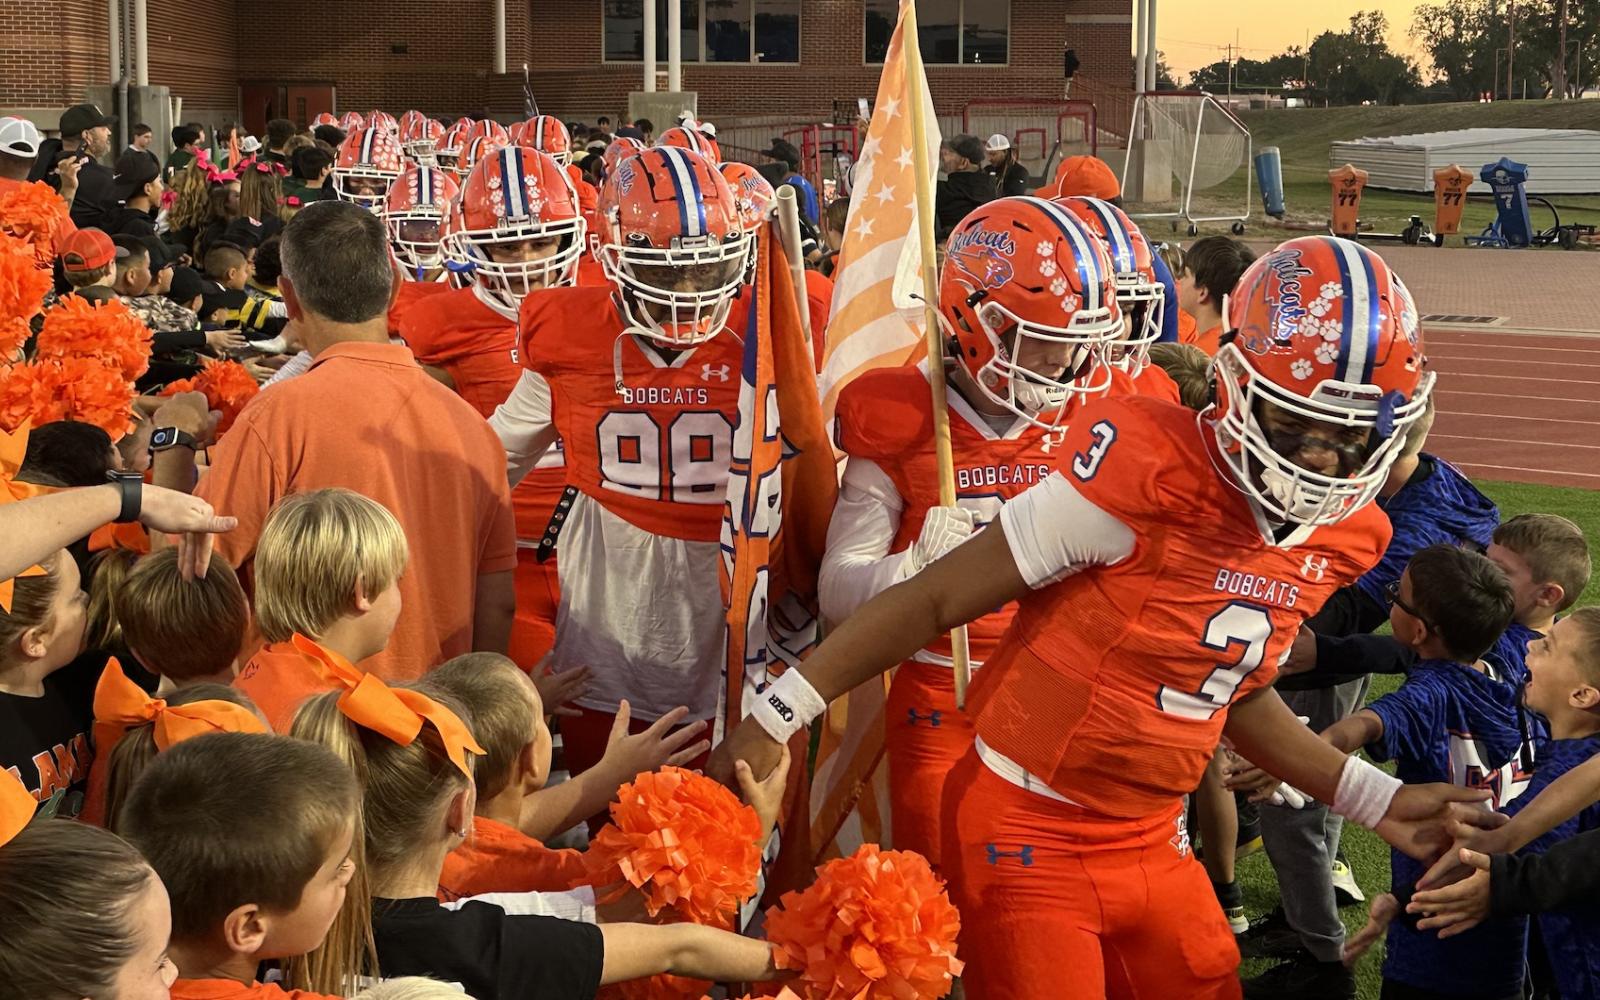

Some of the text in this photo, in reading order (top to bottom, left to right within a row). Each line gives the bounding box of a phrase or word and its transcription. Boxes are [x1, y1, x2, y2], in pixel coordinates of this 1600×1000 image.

[1338, 192, 1357, 206] 77
[1443, 192, 1462, 206] 77
[1500, 194, 1513, 209] 7
[622, 387, 709, 405] BOBCATS
[596, 410, 734, 505] 98
[1072, 419, 1118, 483] 3
[957, 464, 1050, 490] BOBCATS
[1213, 567, 1300, 608] BOBCATS
[1155, 599, 1274, 721] 3
